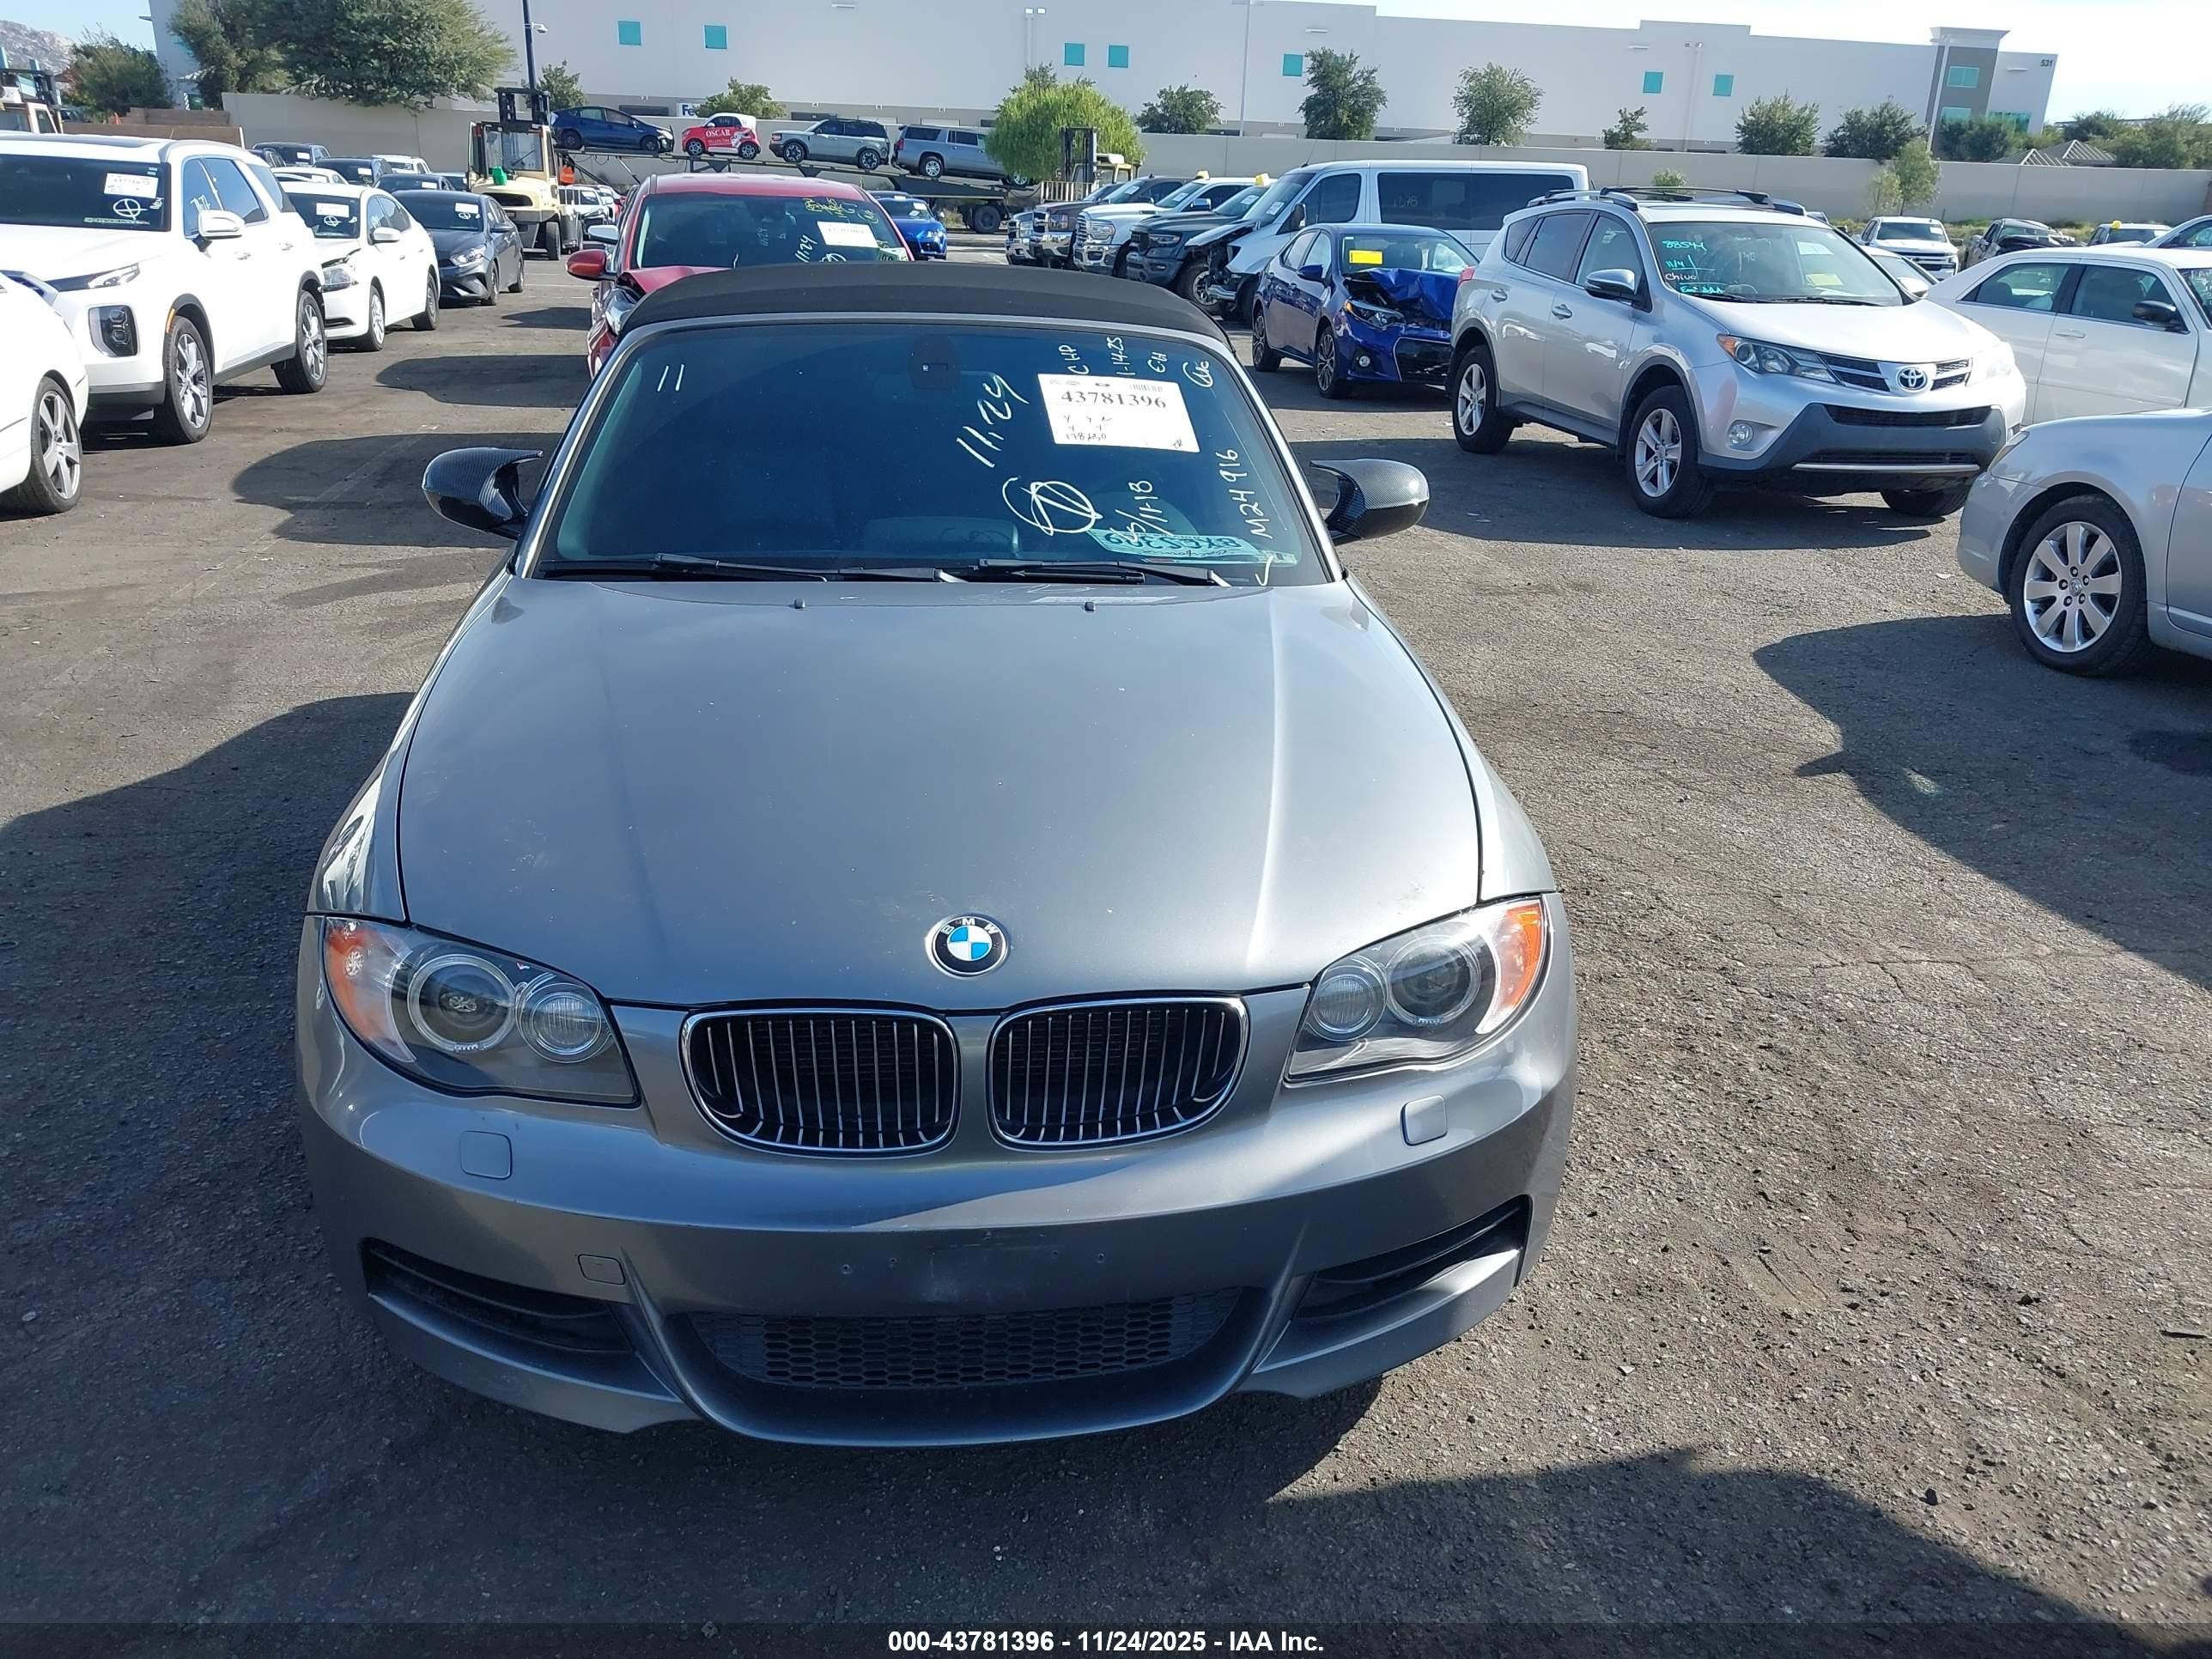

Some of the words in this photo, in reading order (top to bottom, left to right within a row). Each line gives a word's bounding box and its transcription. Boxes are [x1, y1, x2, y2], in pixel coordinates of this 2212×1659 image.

[705, 129, 731, 137] OSCAR
[1060, 391, 1167, 409] 43781396
[941, 918, 999, 935] BMW
